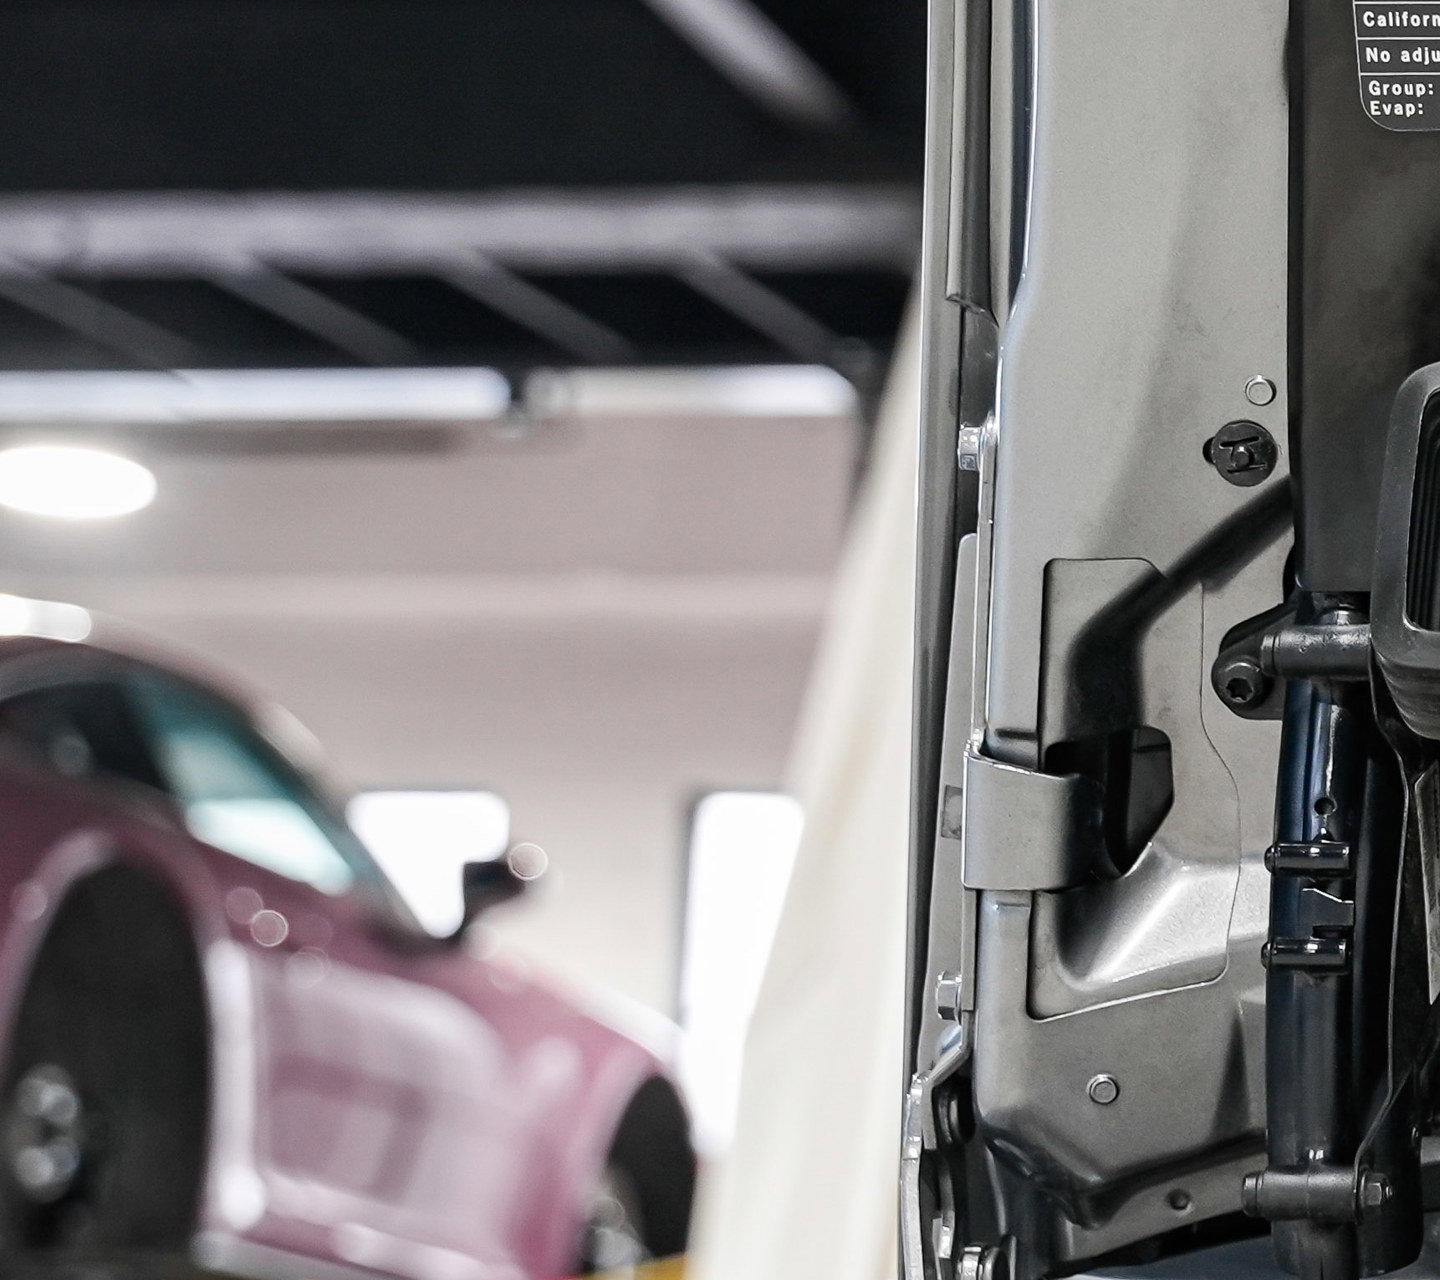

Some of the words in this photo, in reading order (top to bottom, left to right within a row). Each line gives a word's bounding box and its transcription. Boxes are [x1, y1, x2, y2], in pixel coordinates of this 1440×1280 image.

[1365, 47, 1391, 63] No
[1368, 80, 1434, 98] Group:
[1369, 101, 1424, 118] Evap:
